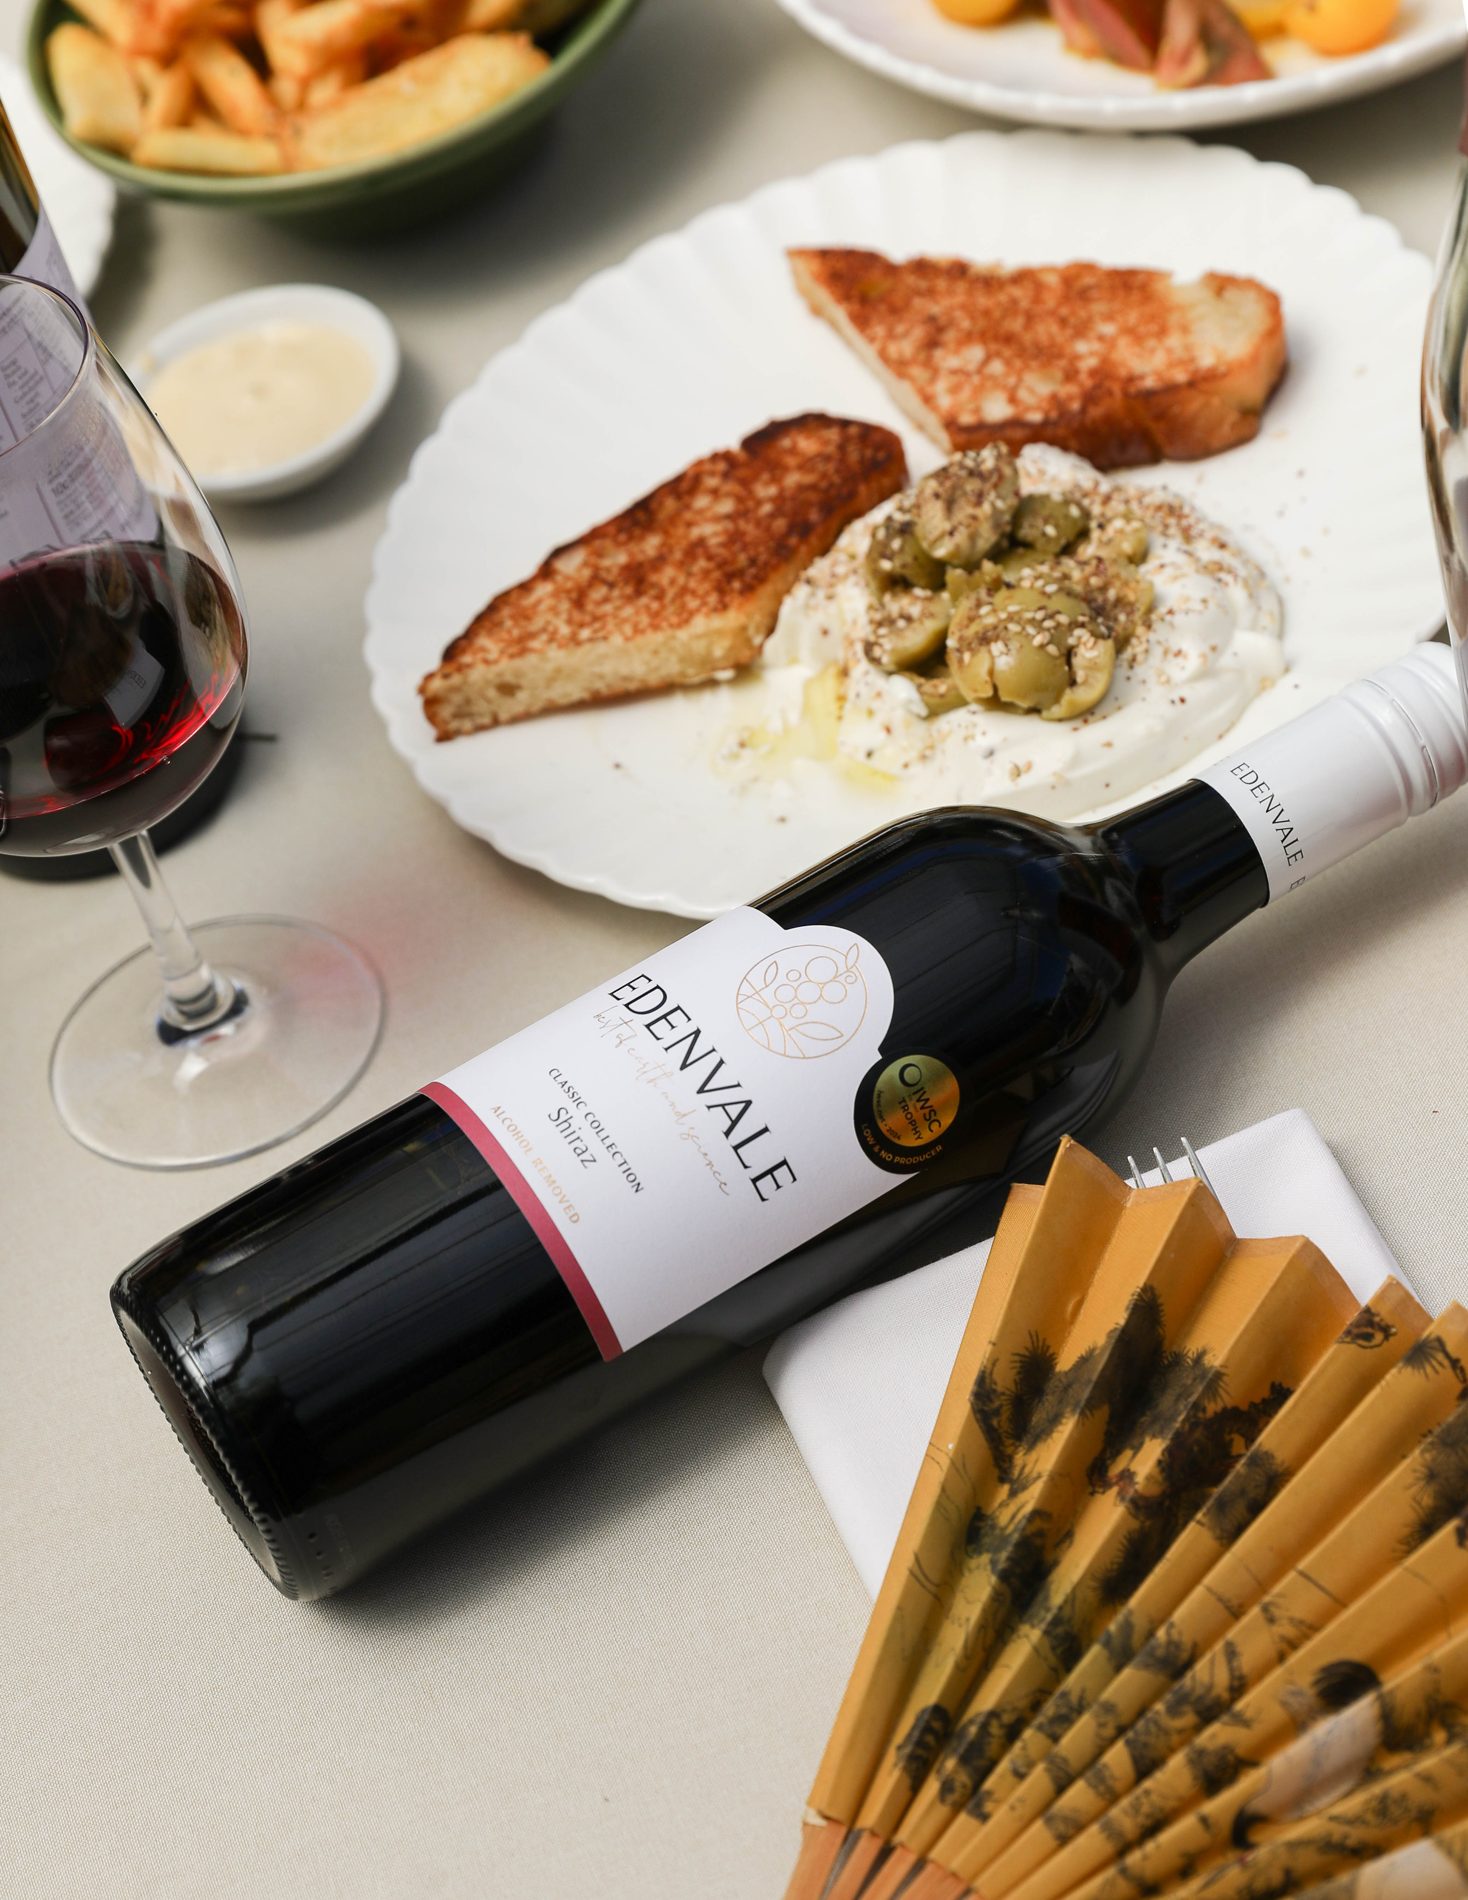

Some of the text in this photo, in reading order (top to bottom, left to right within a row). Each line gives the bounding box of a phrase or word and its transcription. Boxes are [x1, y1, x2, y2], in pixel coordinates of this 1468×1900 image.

[1230, 762, 1304, 866] EDENVALE
[547, 1106, 597, 1169] Shiraz
[548, 1068, 644, 1194] CLASSIC COLLECTION
[593, 1005, 730, 1196] best of earth and science
[608, 973, 797, 1203] EDENVALE
[898, 1097, 924, 1141] TROPHY
[912, 1087, 941, 1133] IWSC
[490, 1105, 581, 1224] ALCOHOL REMOVED
[861, 1123, 875, 1145] LOW
[879, 1150, 893, 1162] NO
[895, 1145, 942, 1165] PRODUCER
